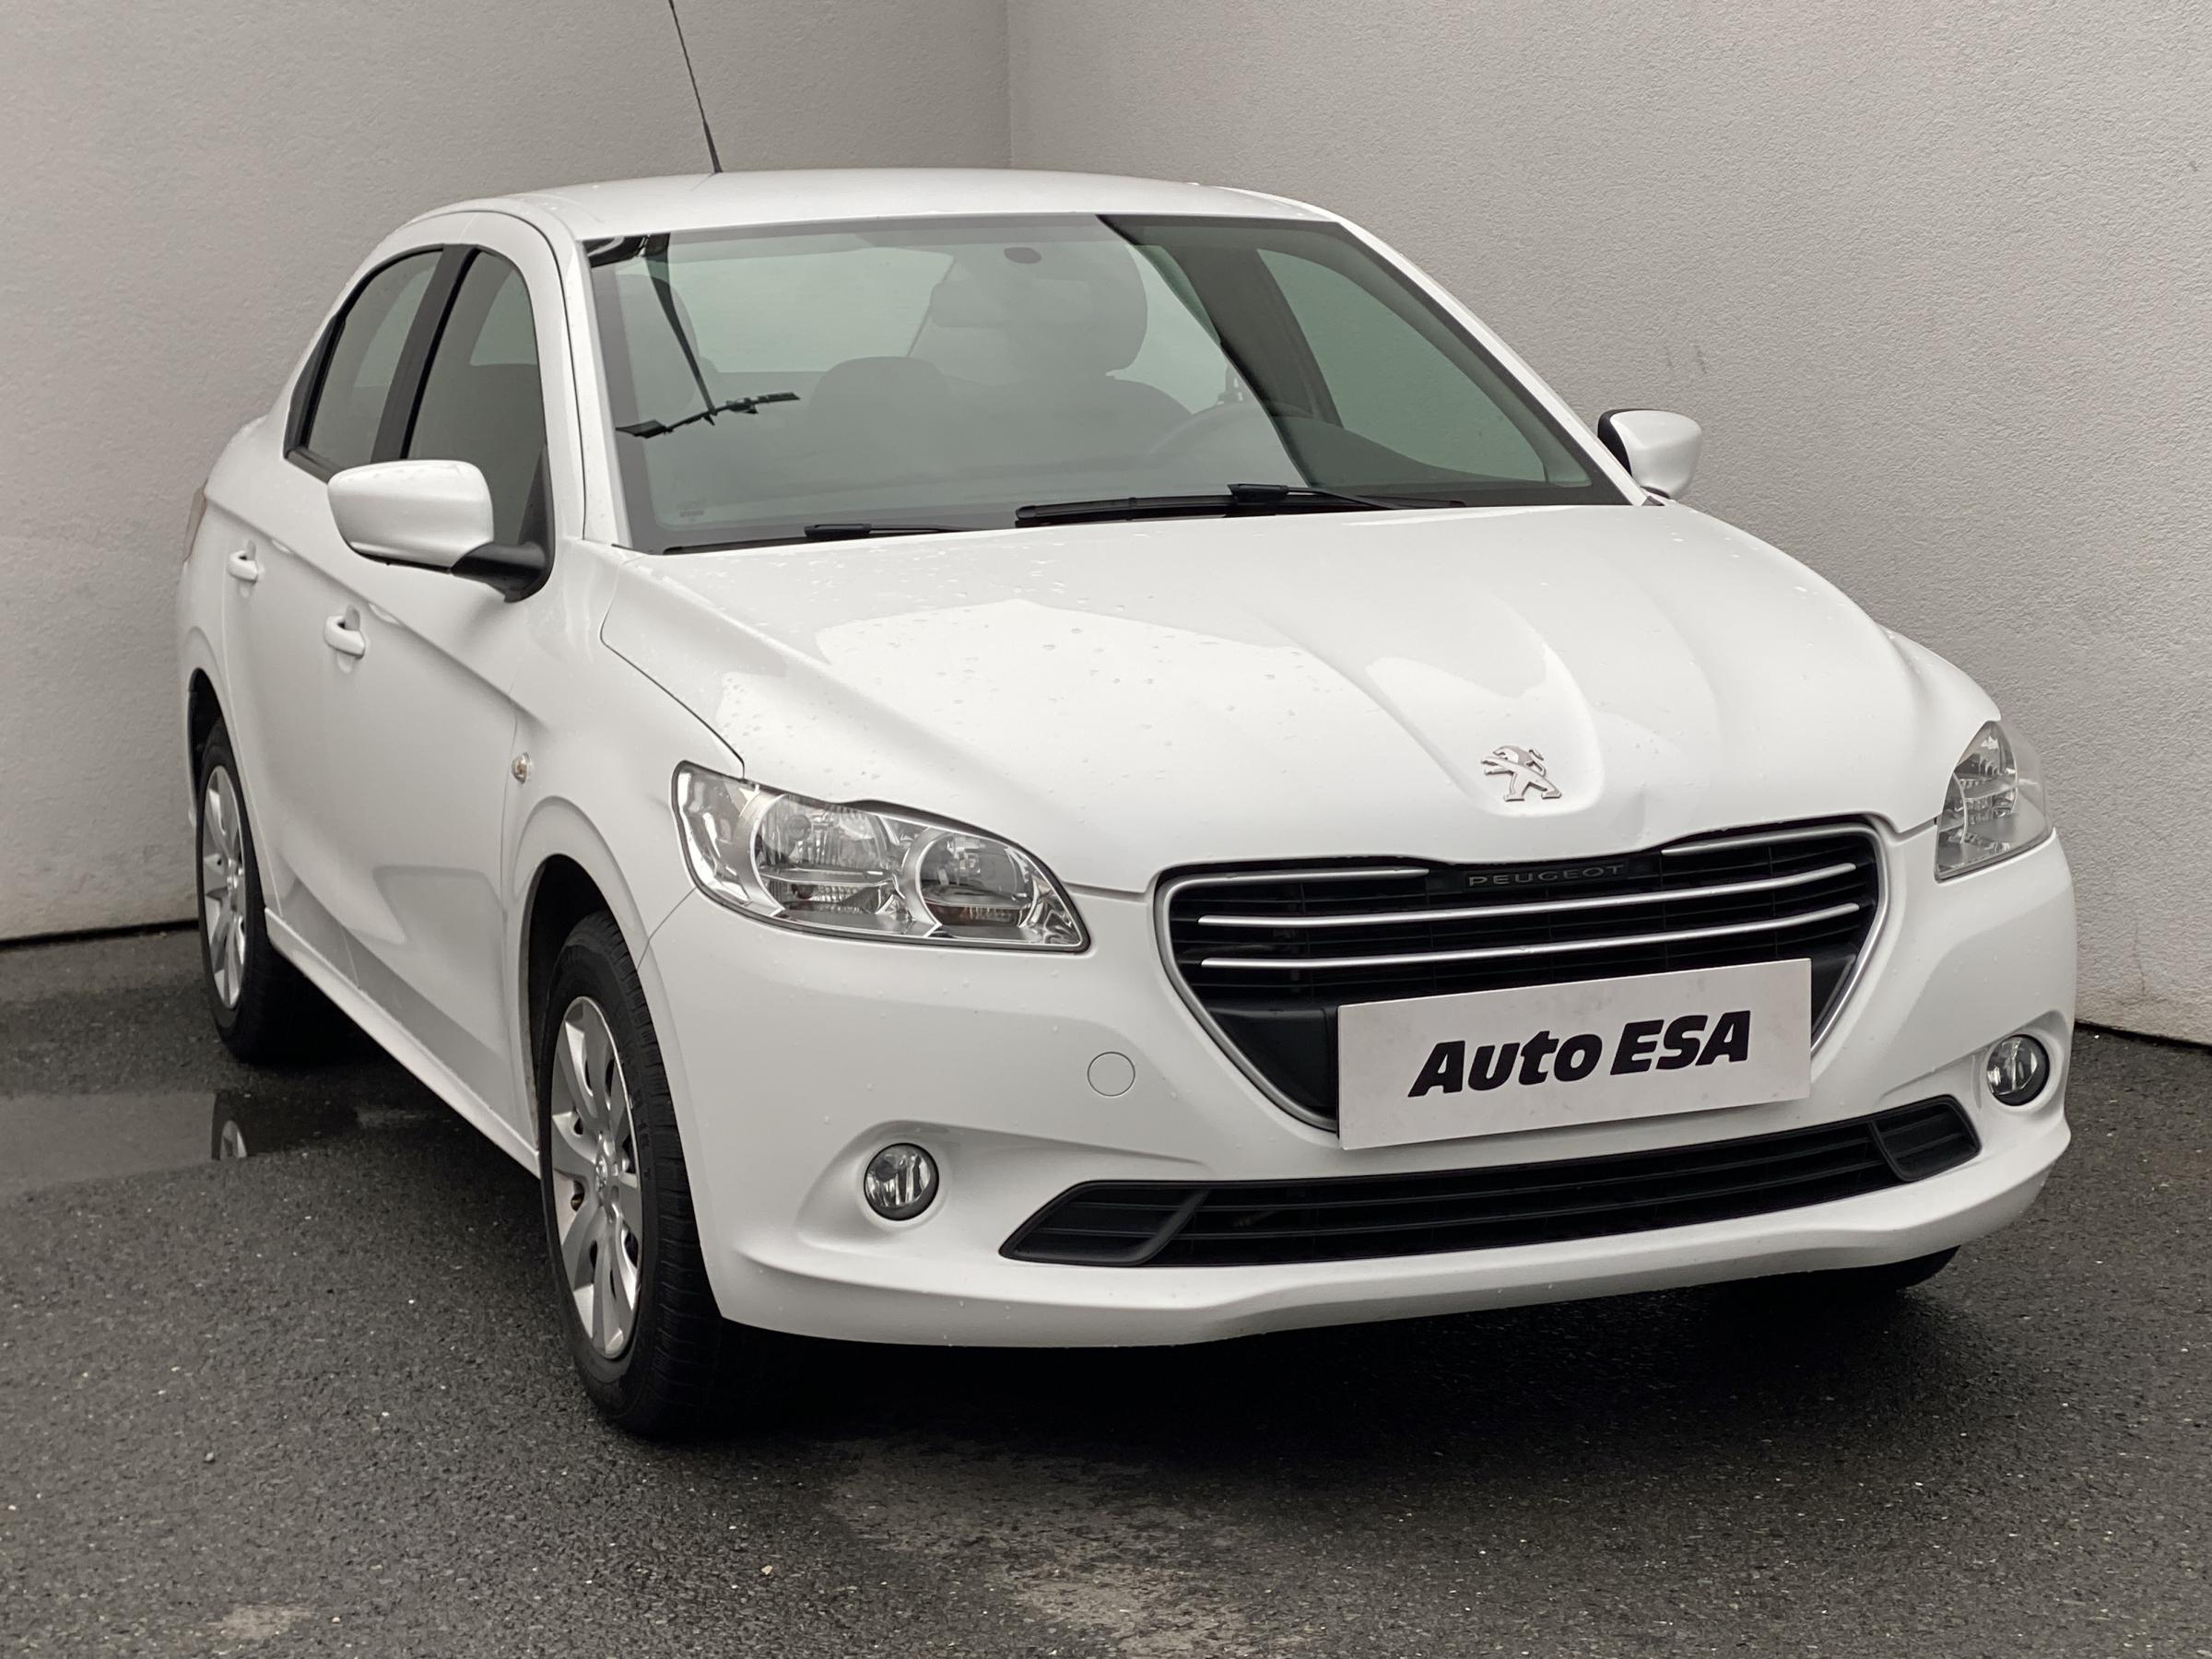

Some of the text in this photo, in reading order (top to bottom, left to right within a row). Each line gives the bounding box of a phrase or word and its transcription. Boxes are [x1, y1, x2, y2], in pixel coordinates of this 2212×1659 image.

[1468, 865, 1625, 886] PEUGEOT
[1407, 1010, 1751, 1098] Auto ESA
